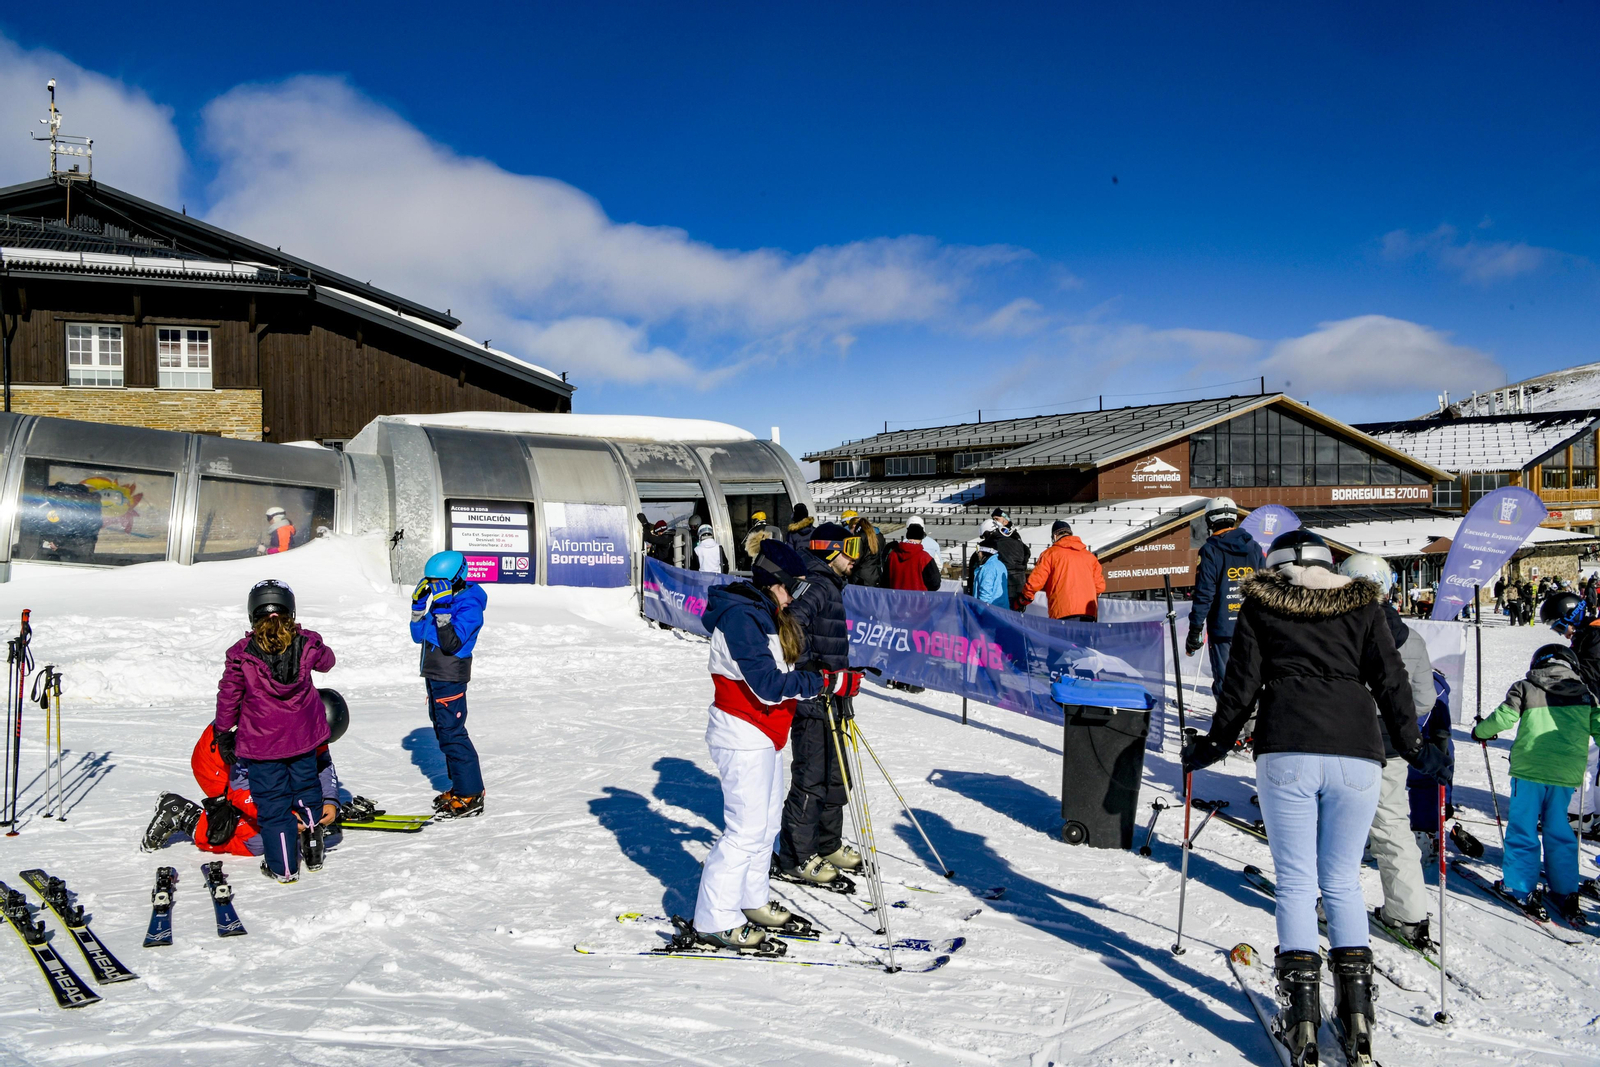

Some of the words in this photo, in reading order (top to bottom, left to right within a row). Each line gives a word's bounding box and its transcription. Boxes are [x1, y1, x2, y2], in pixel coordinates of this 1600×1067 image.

[1332, 488, 1396, 500] BORREGUILES
[1397, 488, 1418, 498] 2700
[1420, 488, 1428, 498] m
[468, 514, 511, 522] INICIACIÓN
[1464, 528, 1490, 538] Escuela
[1491, 532, 1523, 541] Española
[552, 540, 614, 552] Alfombra
[552, 552, 624, 566] Borreguiles
[1469, 559, 1482, 569] 2
[1108, 570, 1131, 578] SIERRA
[1132, 568, 1158, 577] NEVADA
[1158, 566, 1189, 575] BOUTIQUE
[852, 616, 910, 652] sierra
[912, 630, 1004, 671] nevada
